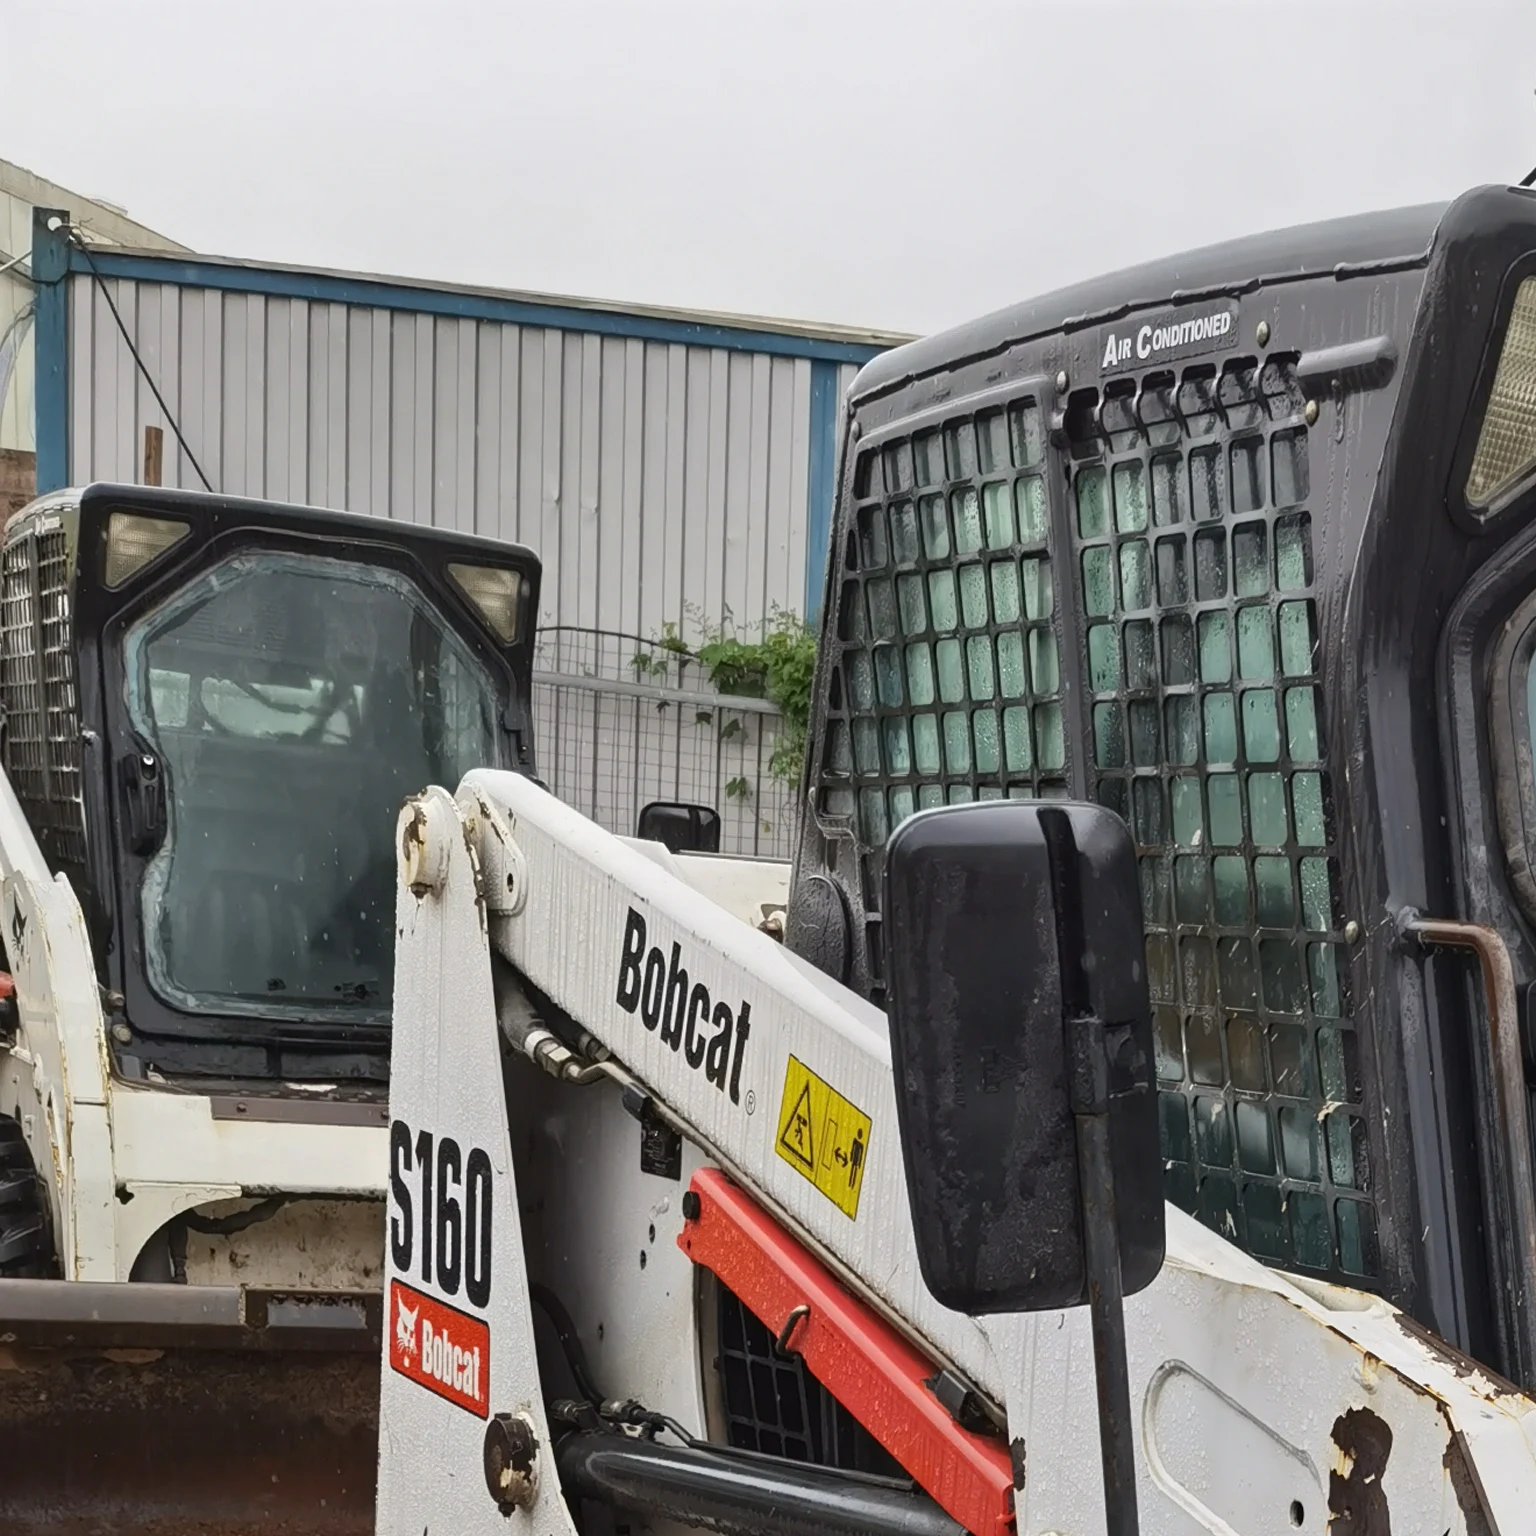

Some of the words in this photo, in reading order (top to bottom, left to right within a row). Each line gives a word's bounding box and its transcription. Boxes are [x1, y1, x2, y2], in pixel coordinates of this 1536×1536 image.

[1101, 333, 1132, 369] AIR
[1136, 311, 1232, 359] CONDITIONED
[615, 905, 751, 1107] Bobcat
[390, 1119, 492, 1309] S160
[421, 1318, 481, 1400] Bobcat
